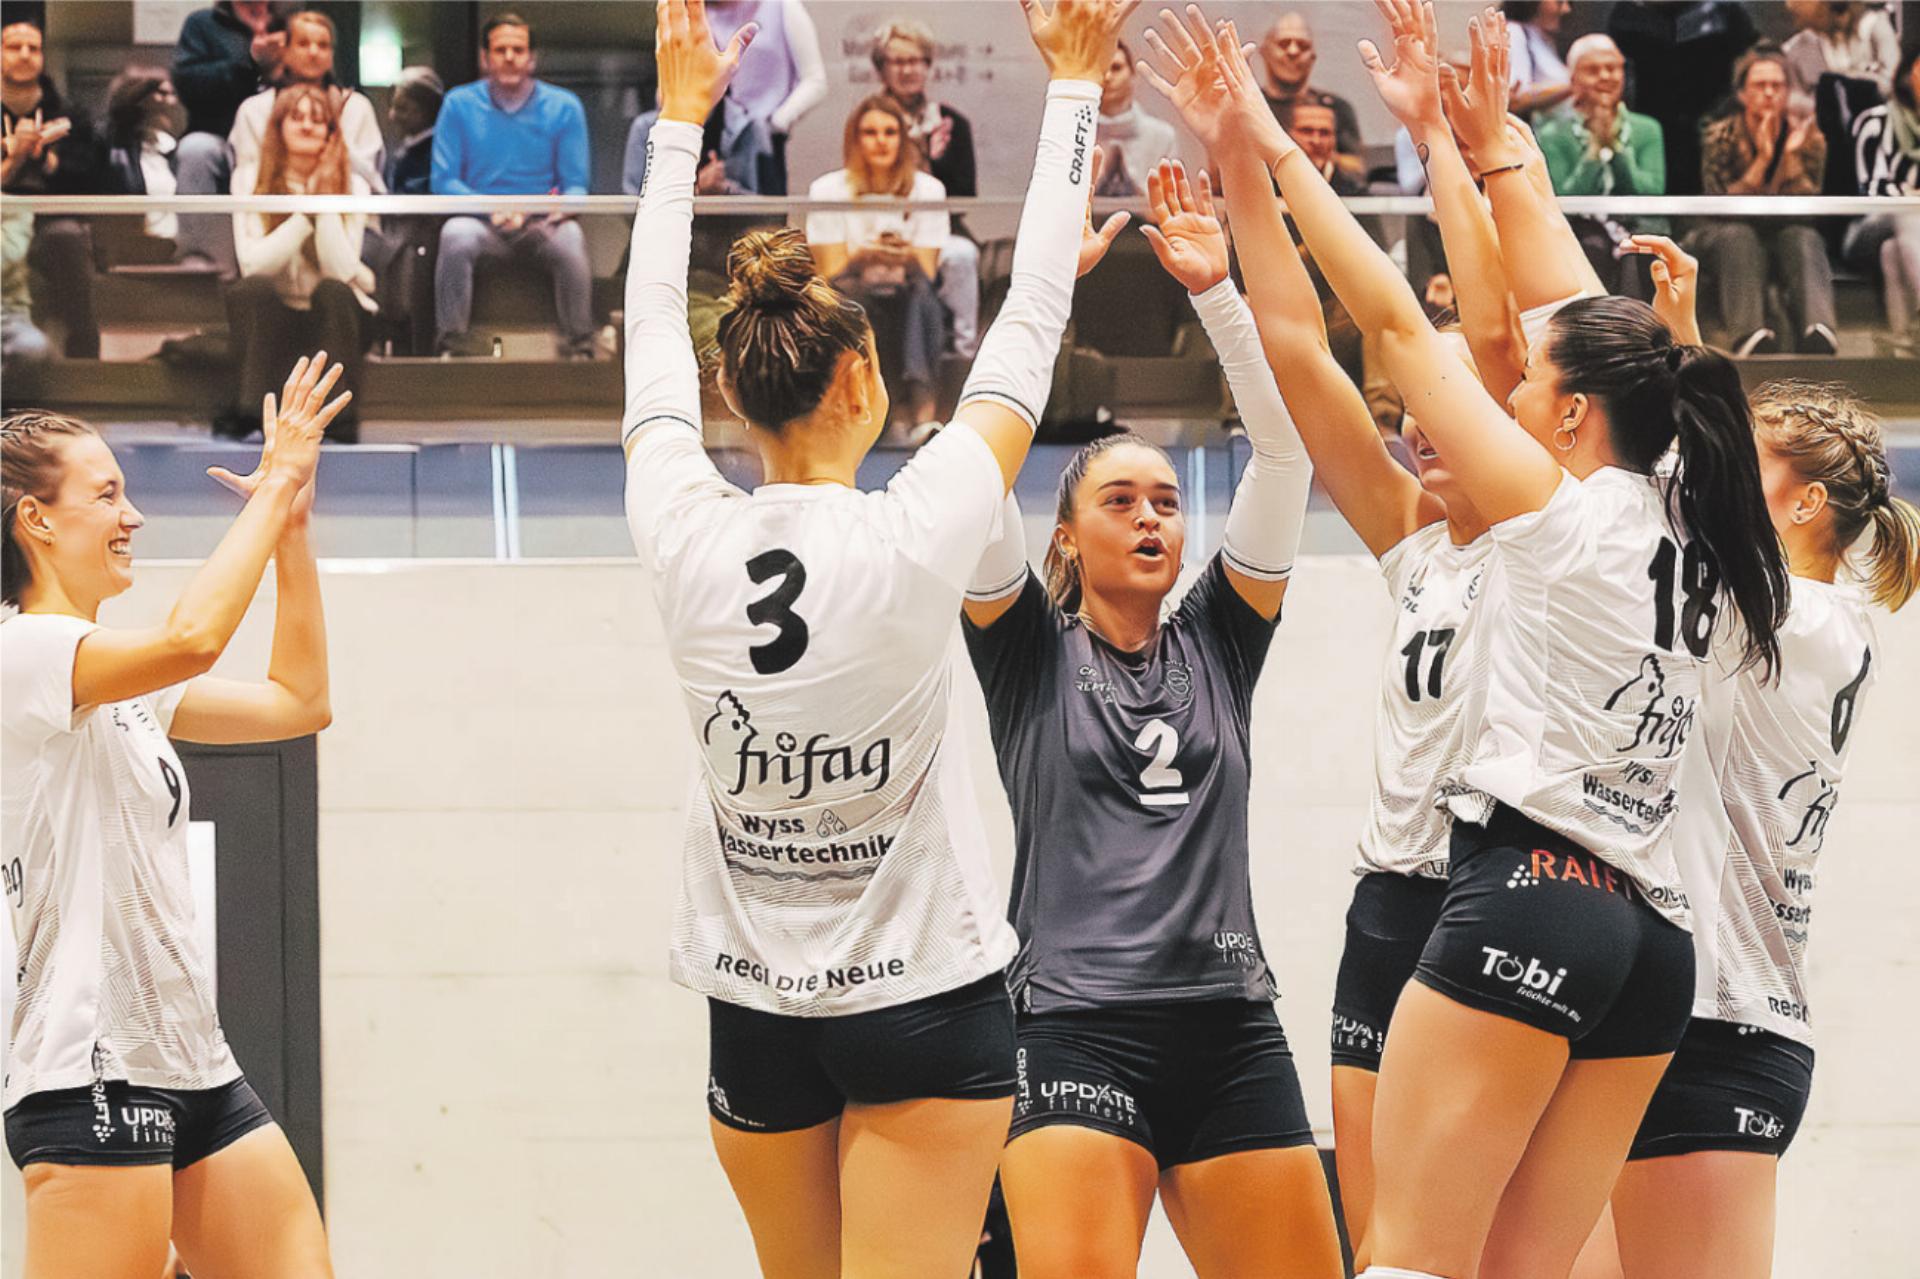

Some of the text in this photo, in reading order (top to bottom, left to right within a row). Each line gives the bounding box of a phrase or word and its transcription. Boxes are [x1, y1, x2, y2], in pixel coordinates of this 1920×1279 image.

[1068, 121, 1088, 185] CRAFT
[745, 548, 809, 675] 3
[1647, 535, 1720, 659] 18
[1400, 628, 1455, 702] 17
[727, 731, 891, 800] frifag
[1134, 718, 1183, 789] 2
[157, 756, 181, 829] 9
[737, 813, 805, 840] Wyss
[826, 958, 905, 988] Neue
[1482, 946, 1568, 996] Tobi
[91, 1083, 111, 1125] RAFT
[1016, 1047, 1030, 1099] CRAFT
[1041, 1081, 1136, 1114] UPDATE
